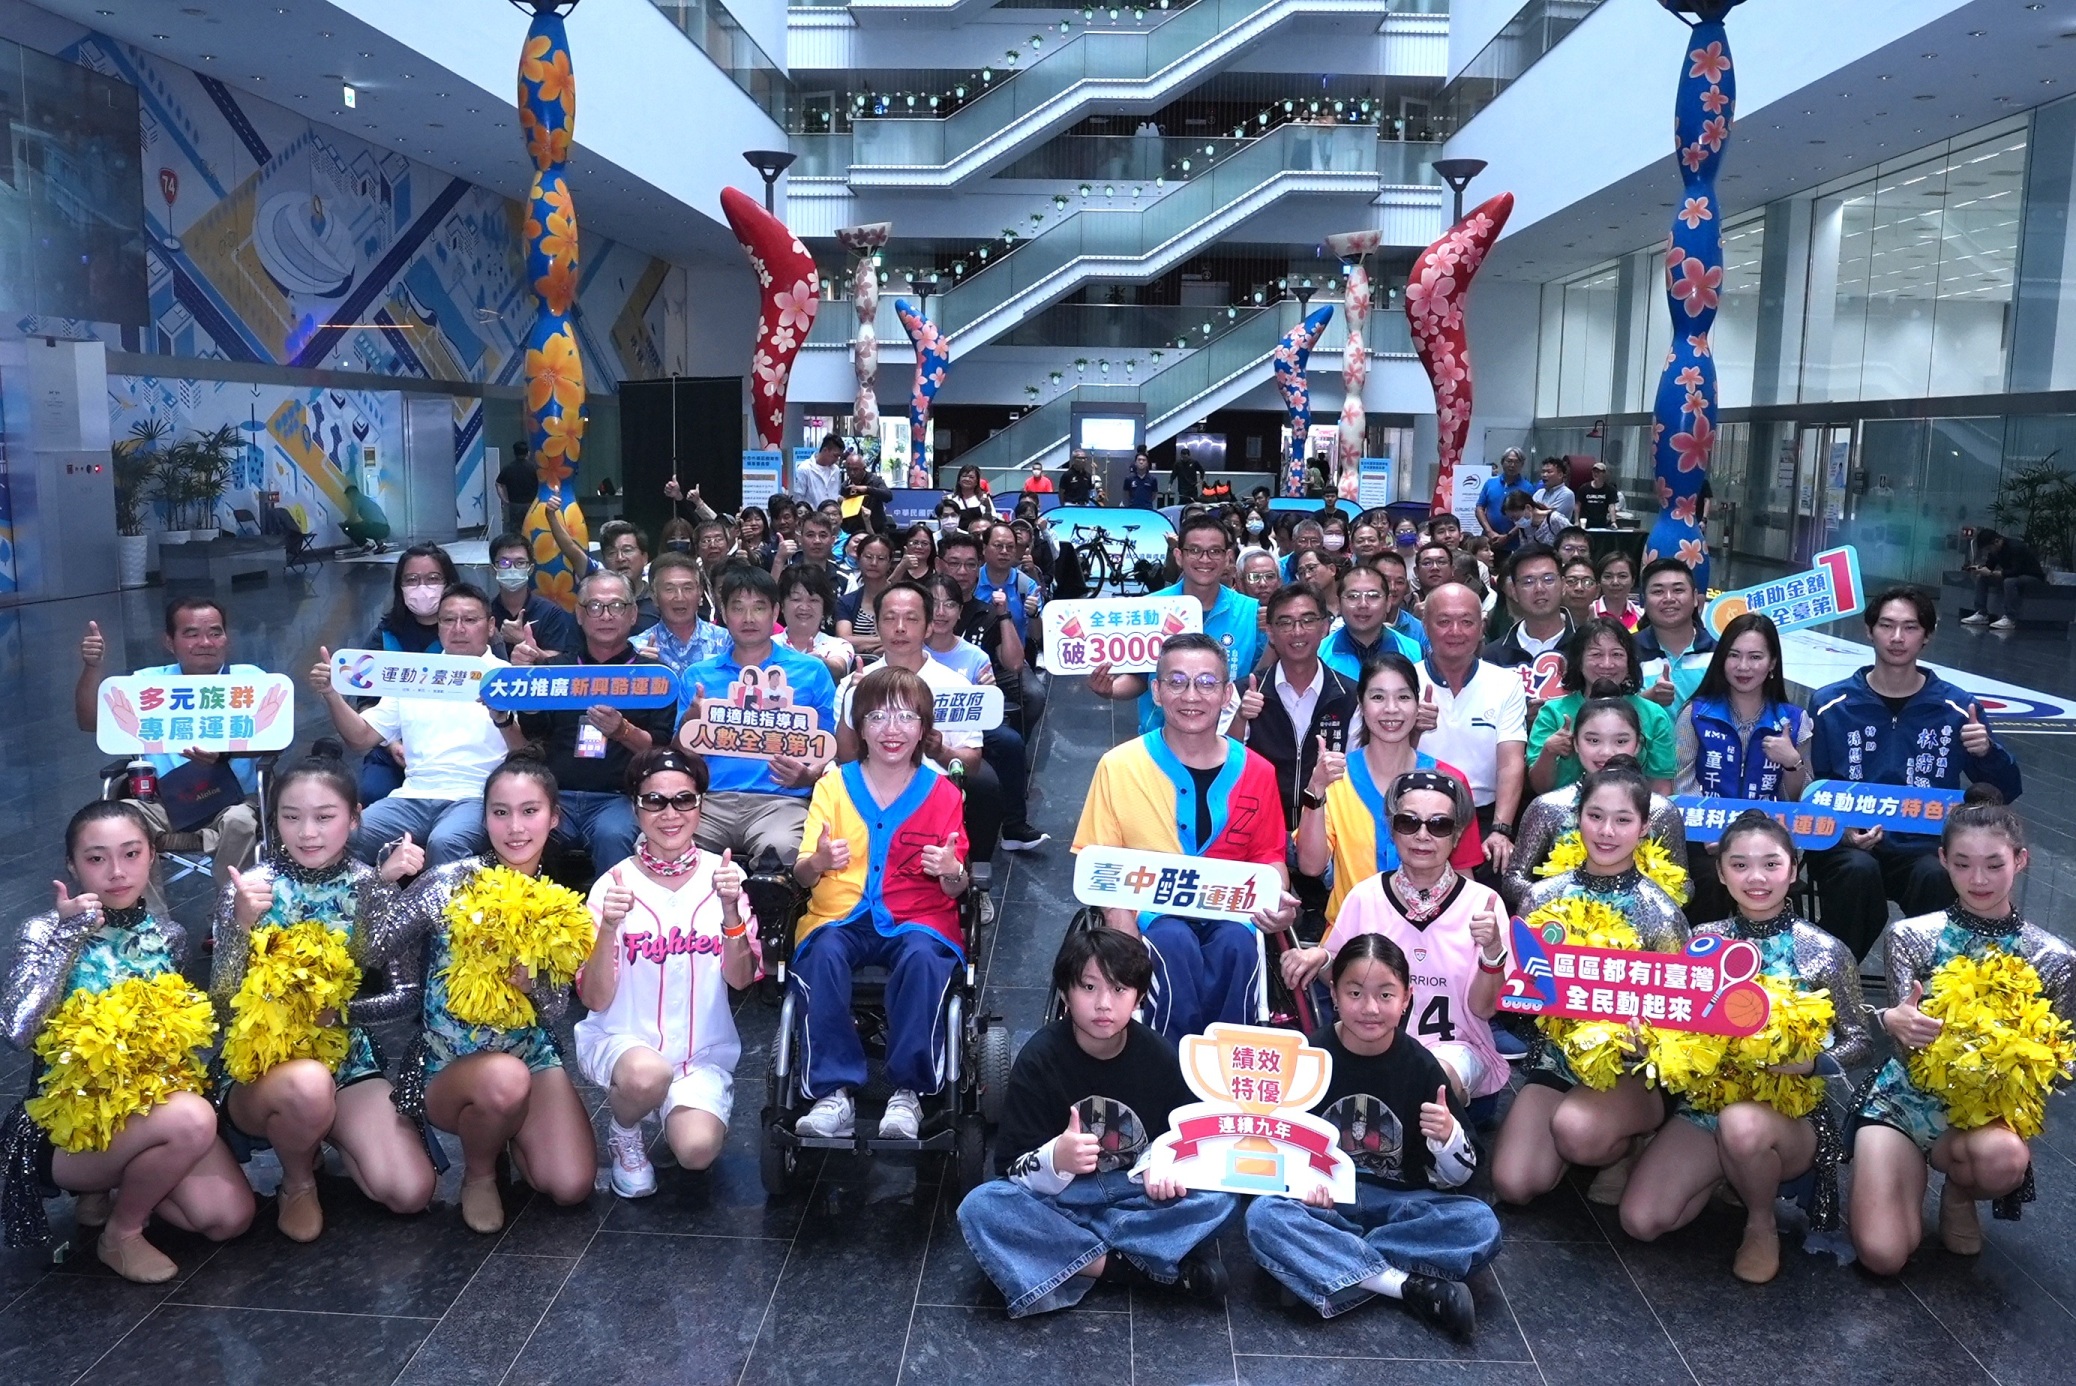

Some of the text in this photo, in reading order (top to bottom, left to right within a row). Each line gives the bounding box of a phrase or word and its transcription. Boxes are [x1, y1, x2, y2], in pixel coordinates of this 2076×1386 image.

[162, 175, 175, 195] 74
[1746, 572, 1827, 610] 補助金額
[1090, 610, 1159, 627] 全年活動
[1772, 596, 1832, 626] 全臺第
[140, 686, 254, 711] 多元族群
[489, 677, 670, 697] 大力推廣新興酷運動
[934, 692, 985, 707] 市政府
[709, 706, 808, 731] 體適能指導員
[934, 707, 983, 722] 運動局
[138, 715, 254, 740] 專屬運動
[1704, 730, 1727, 740] KMT
[690, 724, 826, 757] 人數全臺第1
[1088, 862, 1257, 914] 臺中酷運動
[1553, 953, 1714, 992] 區區都有i臺灣
[1566, 985, 1692, 1022] 全民動起來
[1232, 1046, 1281, 1073] 績效
[1231, 1076, 1280, 1104] 特優
[1218, 1116, 1292, 1139] 連續九年
